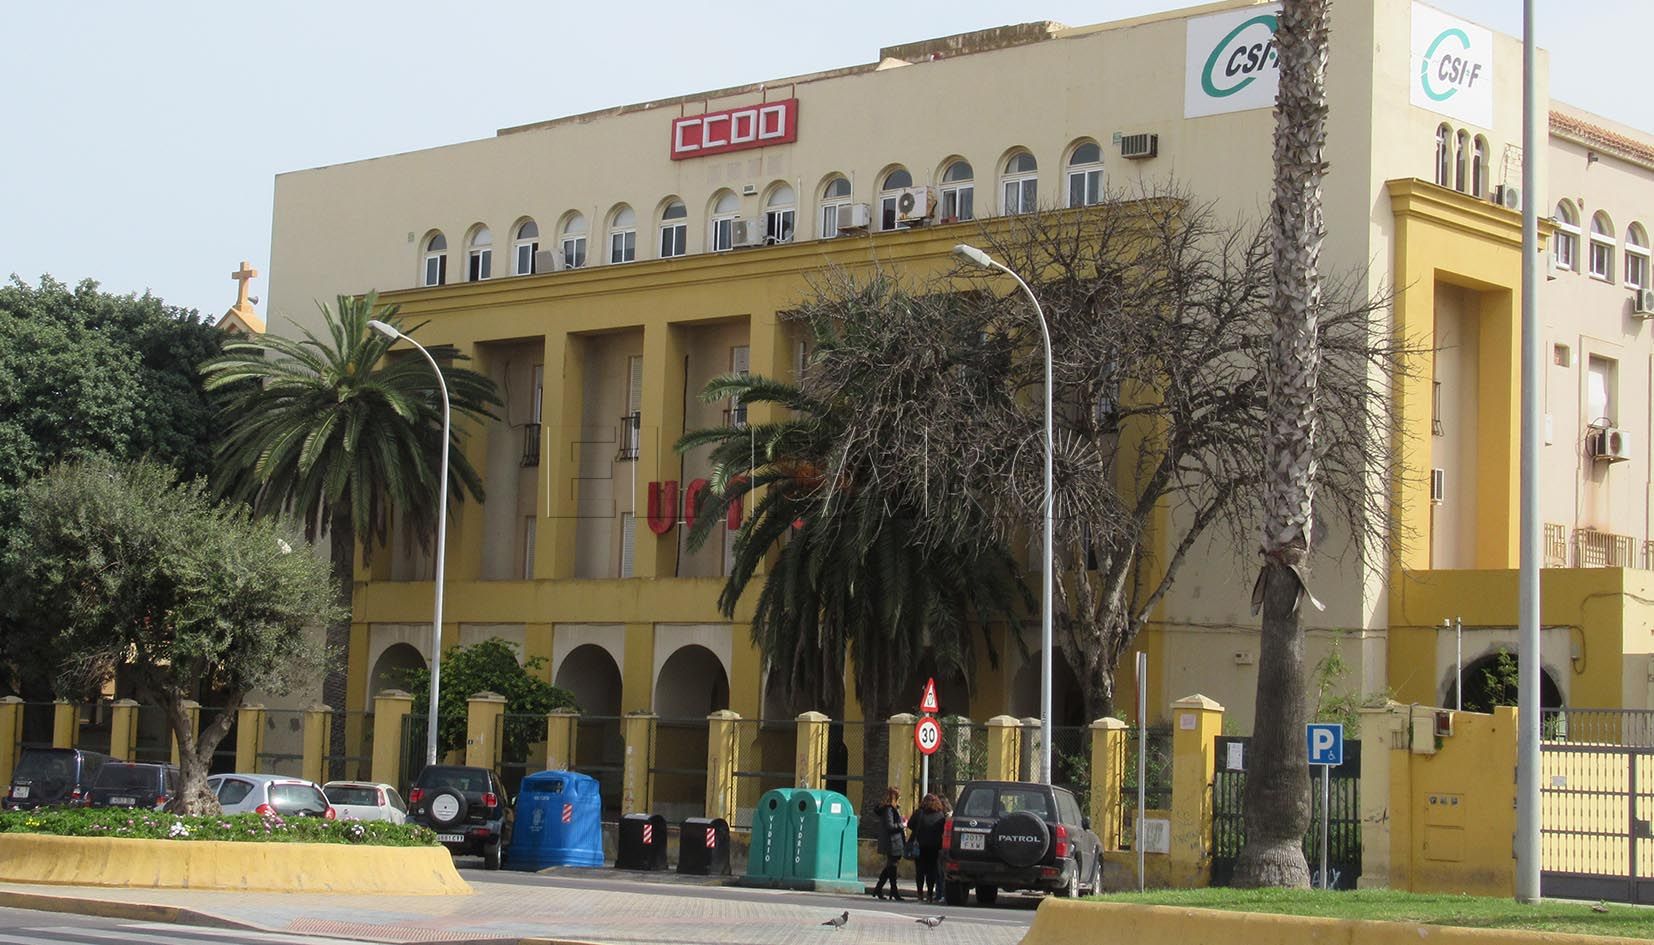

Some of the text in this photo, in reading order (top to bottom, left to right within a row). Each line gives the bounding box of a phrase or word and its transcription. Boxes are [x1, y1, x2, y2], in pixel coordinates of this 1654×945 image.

[675, 105, 786, 152] CCOO
[921, 728, 935, 743] 30
[1312, 728, 1335, 760] P
[765, 815, 774, 862] VIDRIO
[795, 816, 805, 863] VIDRIO
[998, 834, 1041, 843] PATROL
